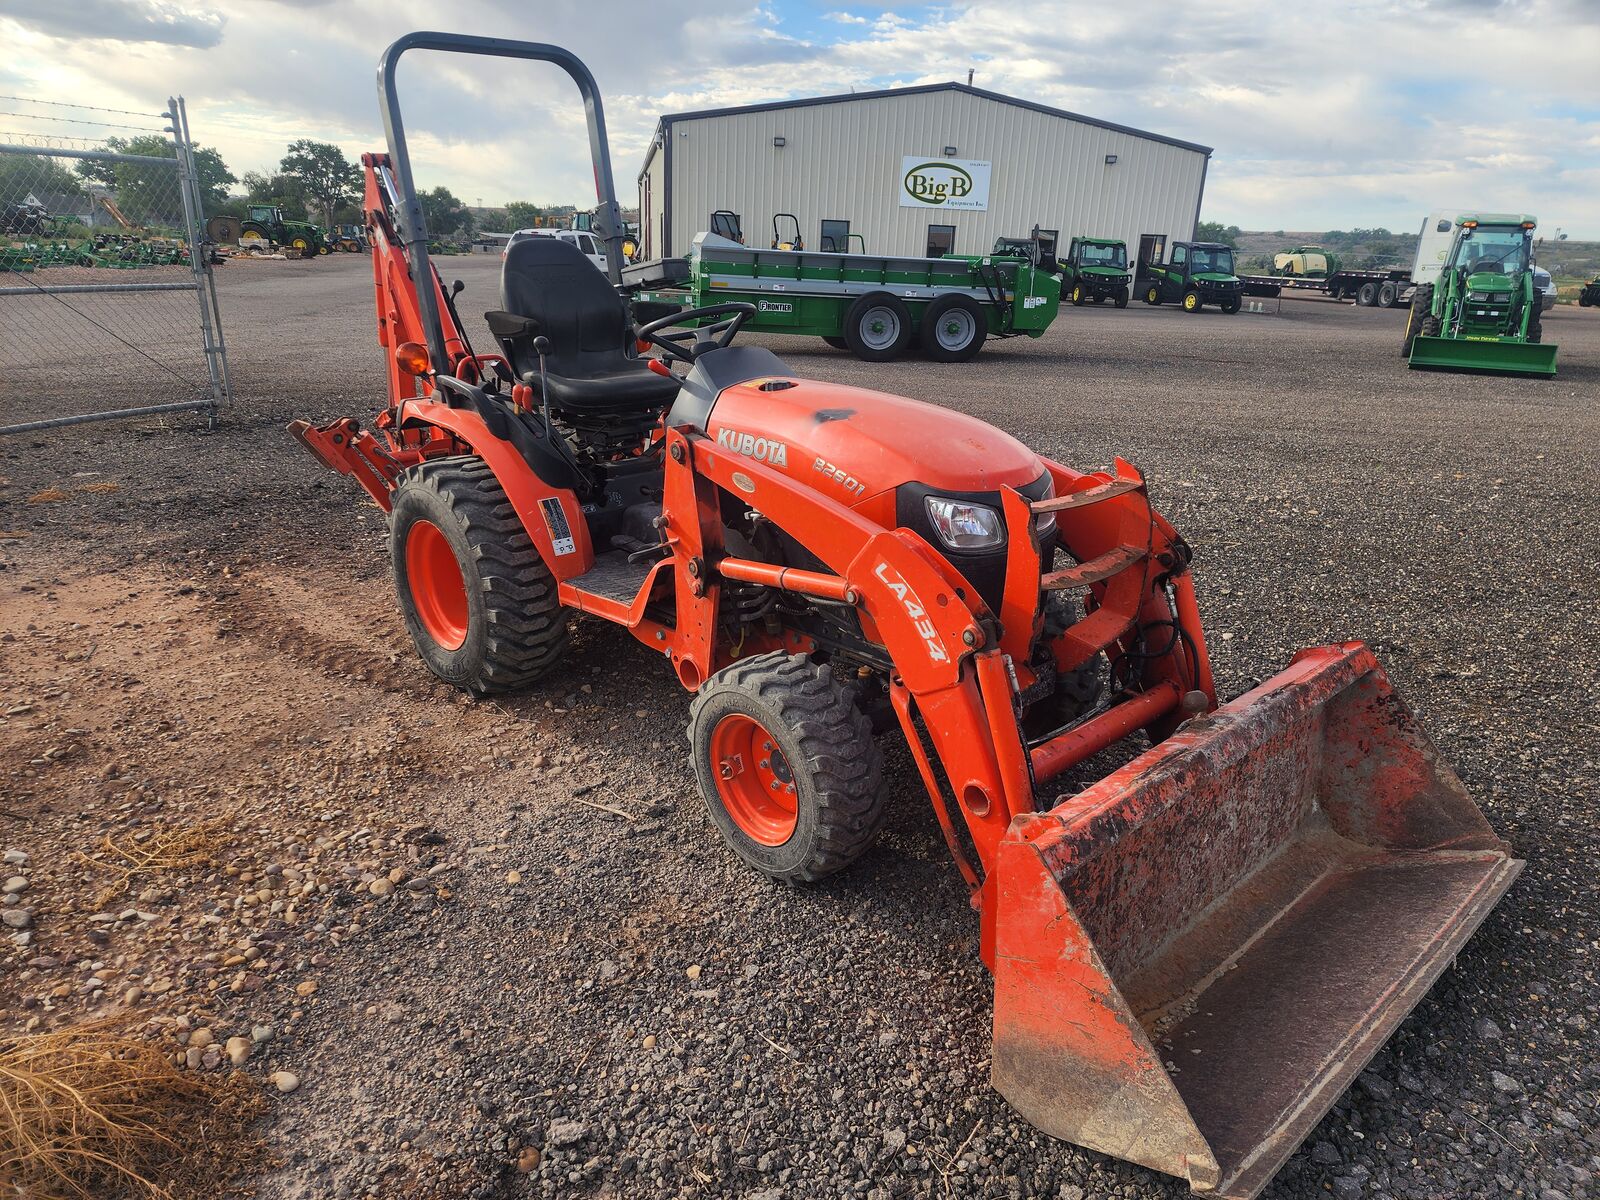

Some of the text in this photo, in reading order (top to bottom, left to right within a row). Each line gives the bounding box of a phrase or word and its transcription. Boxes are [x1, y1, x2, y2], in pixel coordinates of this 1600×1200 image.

[911, 174, 968, 203] Big B
[759, 301, 792, 312] FRONTIER
[717, 427, 788, 468] KUBOTA
[812, 456, 866, 497] B2601
[875, 562, 948, 662] LA434
